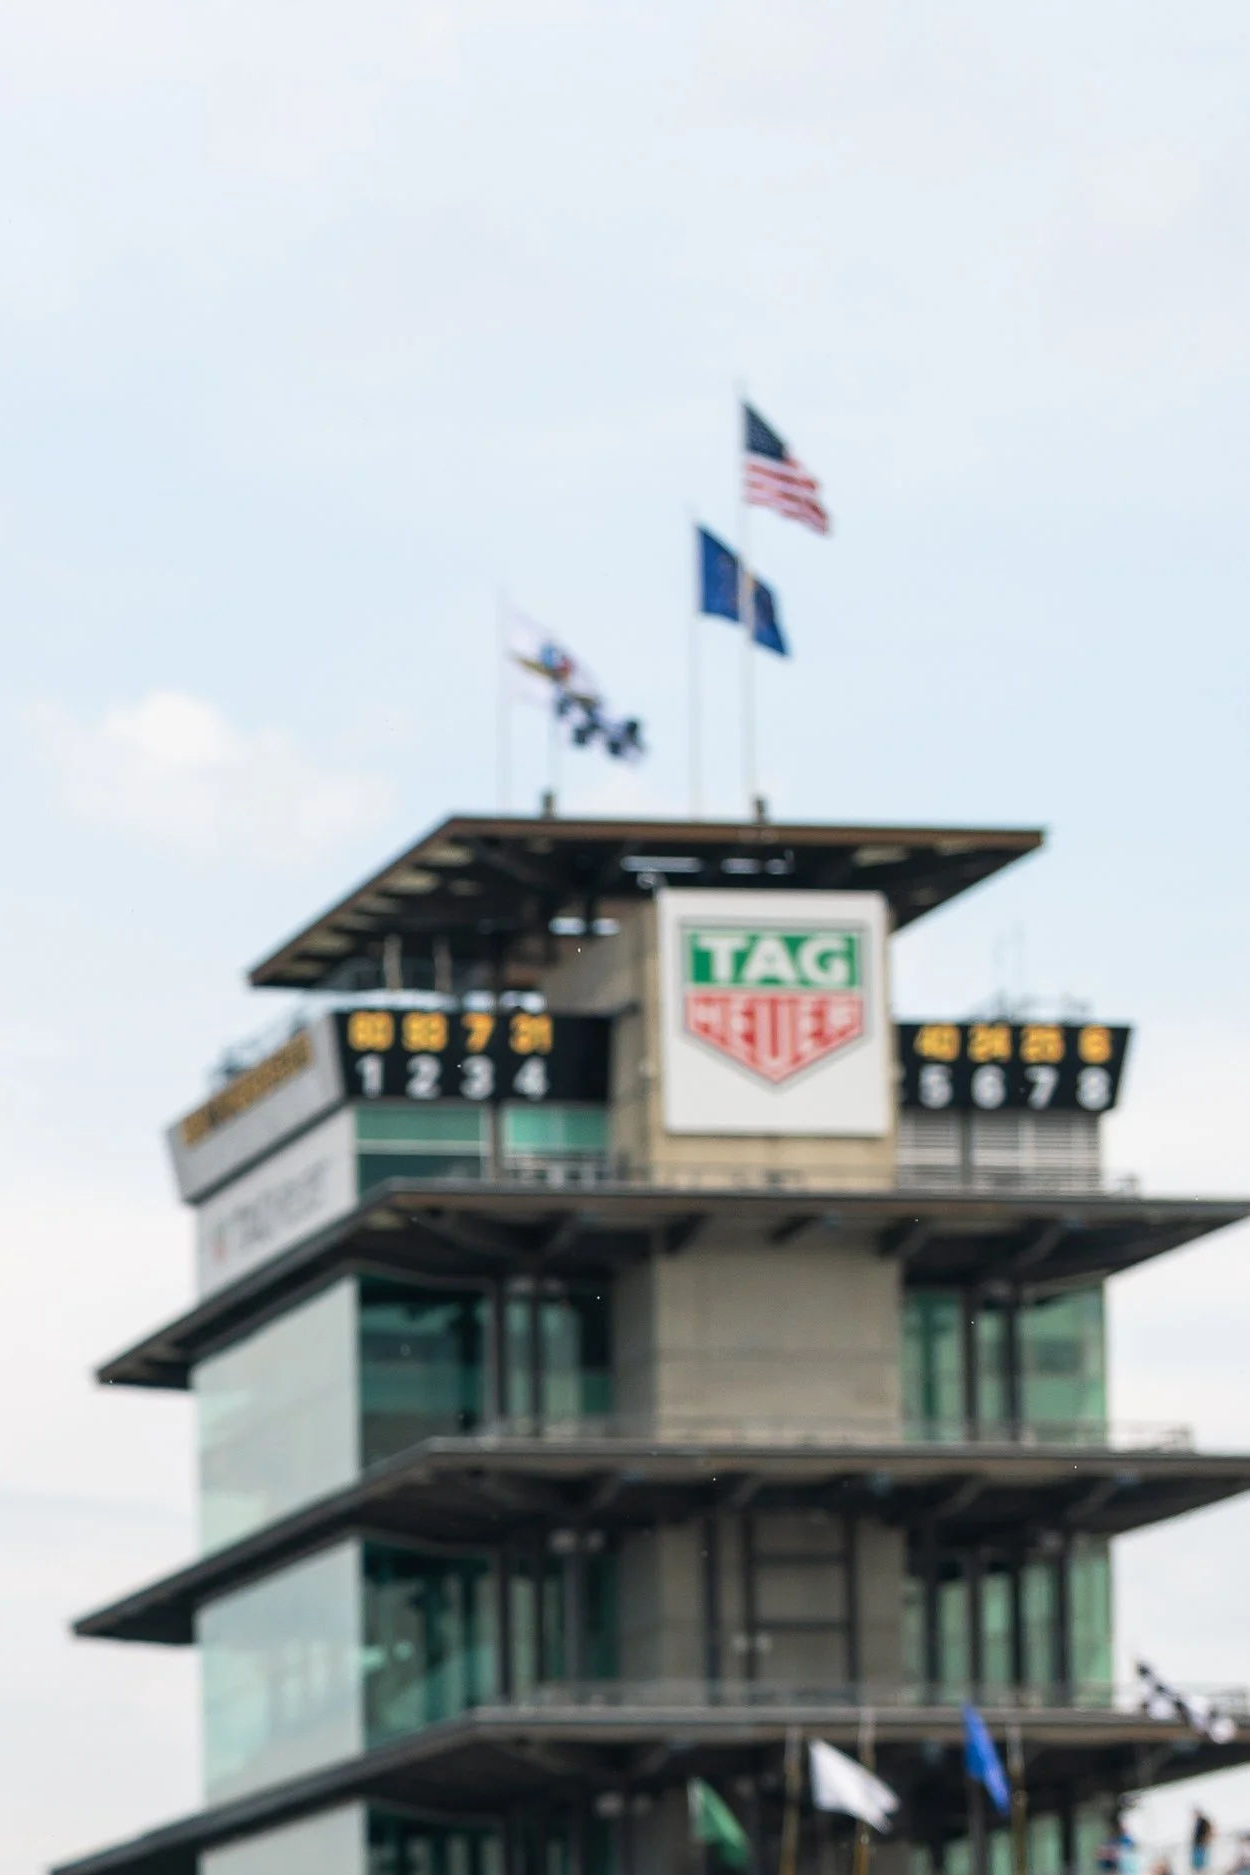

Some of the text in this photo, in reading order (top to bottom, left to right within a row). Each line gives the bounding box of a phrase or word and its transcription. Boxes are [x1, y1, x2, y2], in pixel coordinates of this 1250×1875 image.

[695, 932, 851, 985] TAG
[460, 1012, 495, 1053] 7
[509, 1013, 553, 1054] 31
[690, 992, 861, 1070] HEUER
[1077, 1024, 1112, 1064] 6
[355, 1053, 385, 1098] 1
[406, 1055, 442, 1099] 2
[459, 1055, 495, 1100] 3
[512, 1055, 549, 1100] 4
[918, 1063, 1112, 1111] 5 6 7 8
